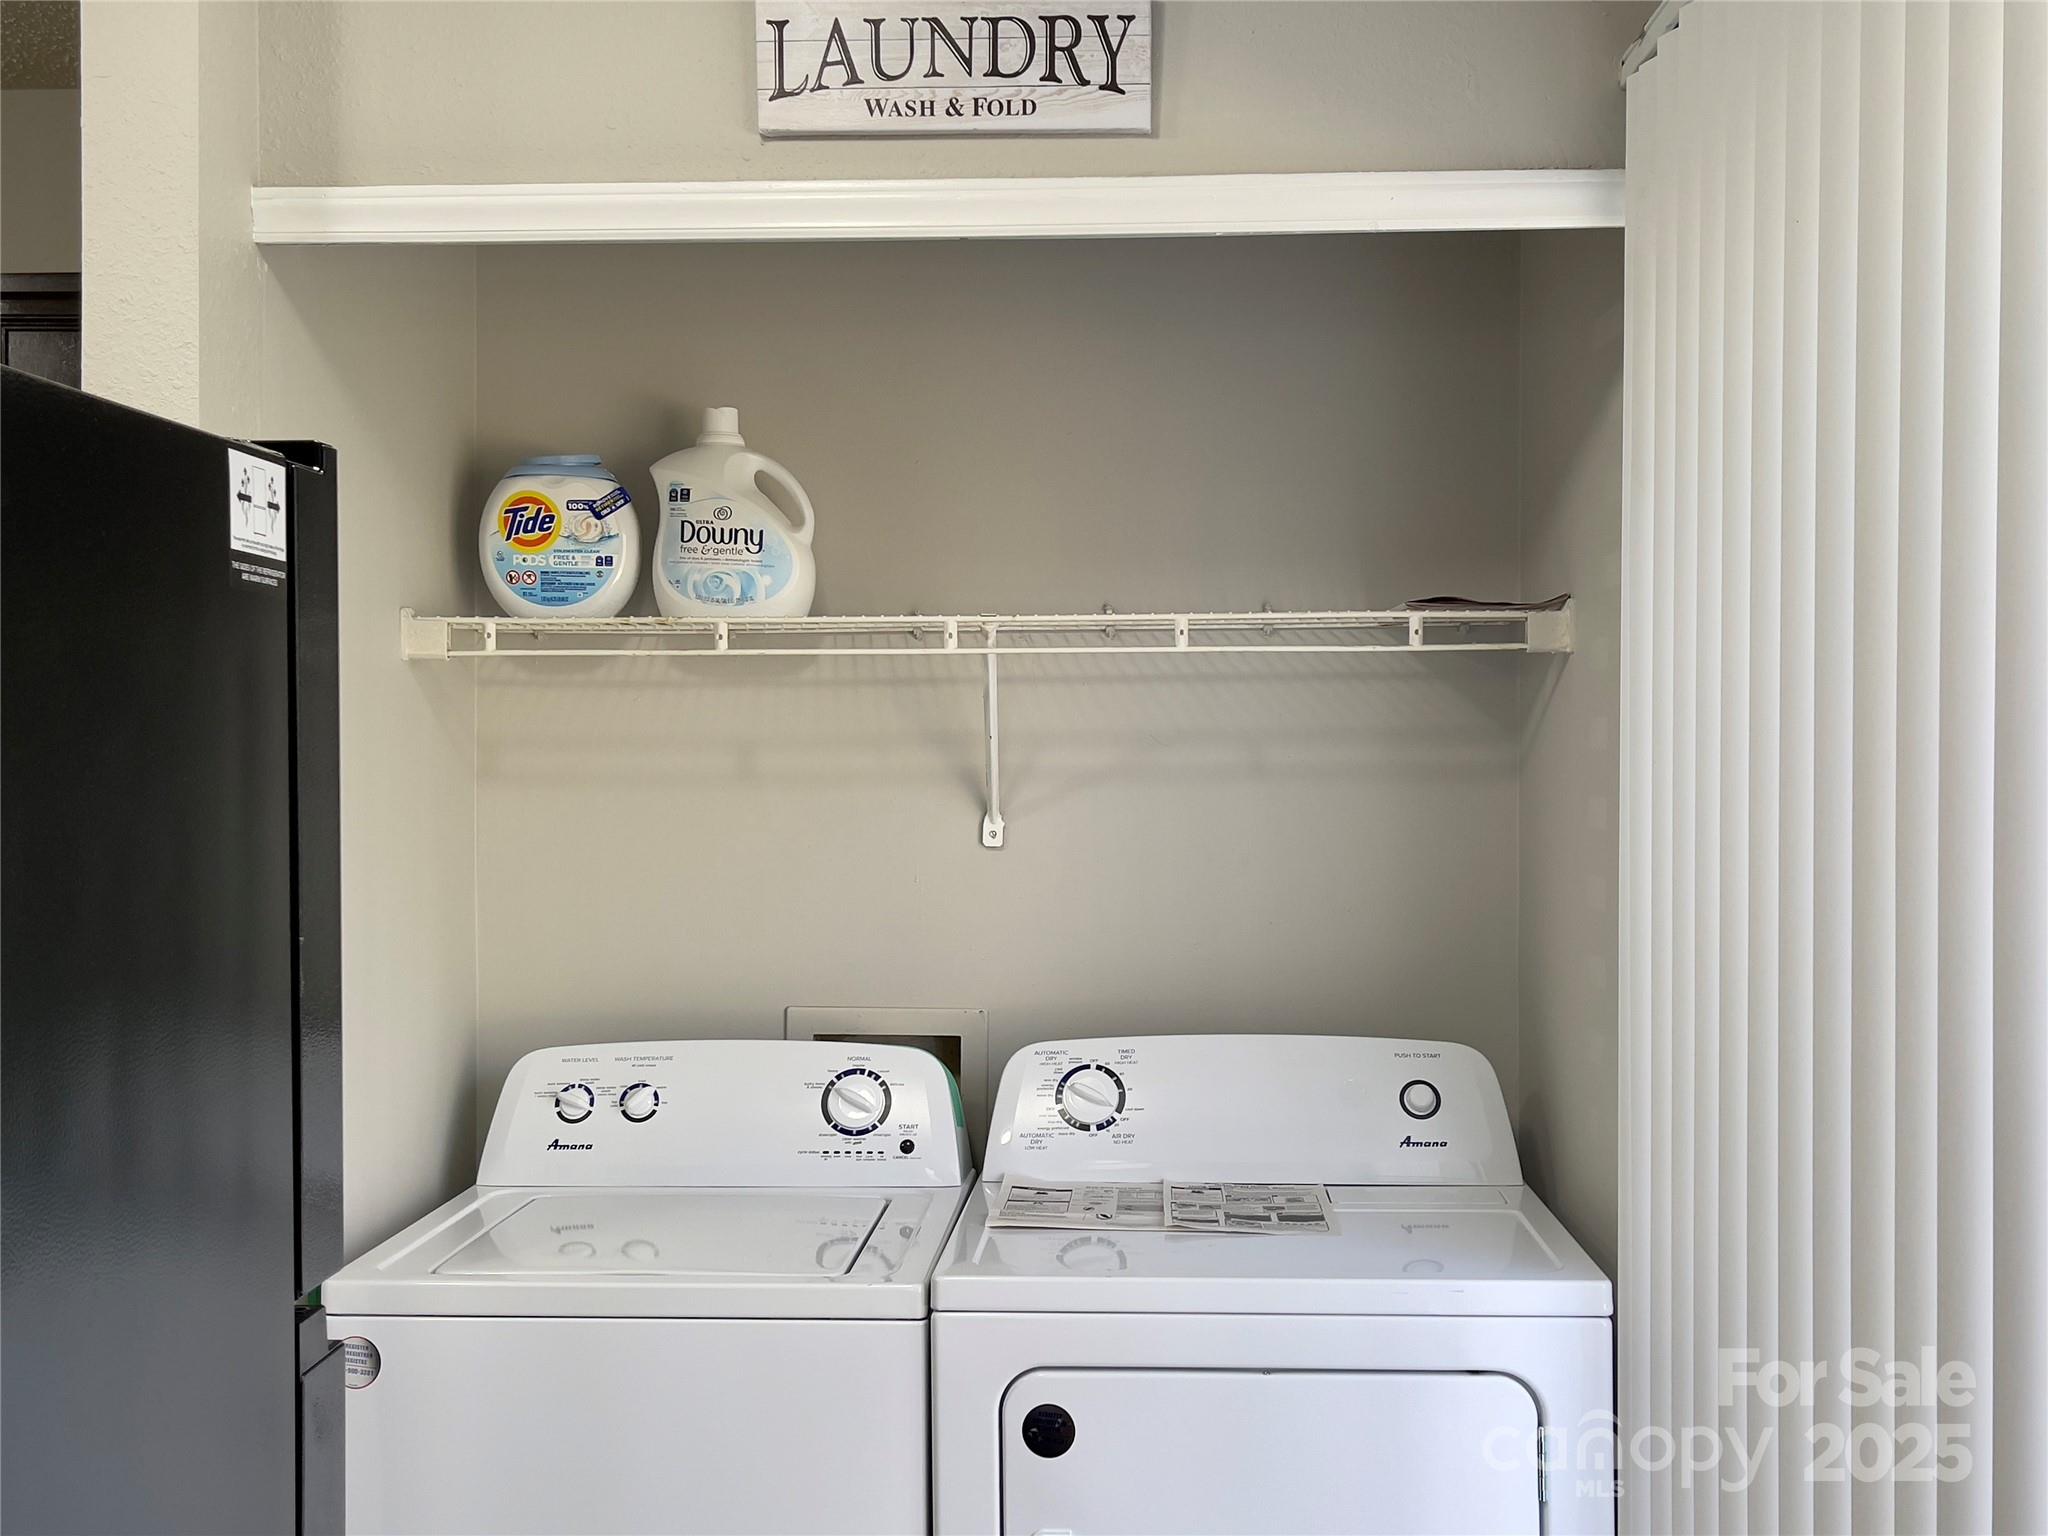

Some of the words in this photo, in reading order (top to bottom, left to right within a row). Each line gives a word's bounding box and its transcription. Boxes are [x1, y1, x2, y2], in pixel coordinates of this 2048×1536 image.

[766, 14, 1137, 101] LAUNDRY
[864, 97, 936, 118] WASH
[945, 97, 965, 118] &
[972, 97, 1038, 118] FOLD
[503, 504, 556, 542] Tide
[680, 520, 764, 554] Downy
[680, 545, 698, 554] free
[701, 545, 713, 555] &
[712, 547, 744, 556] gentle
[512, 554, 546, 566] PODS
[547, 1138, 593, 1151] Amana
[1399, 1135, 1448, 1148] Amana
